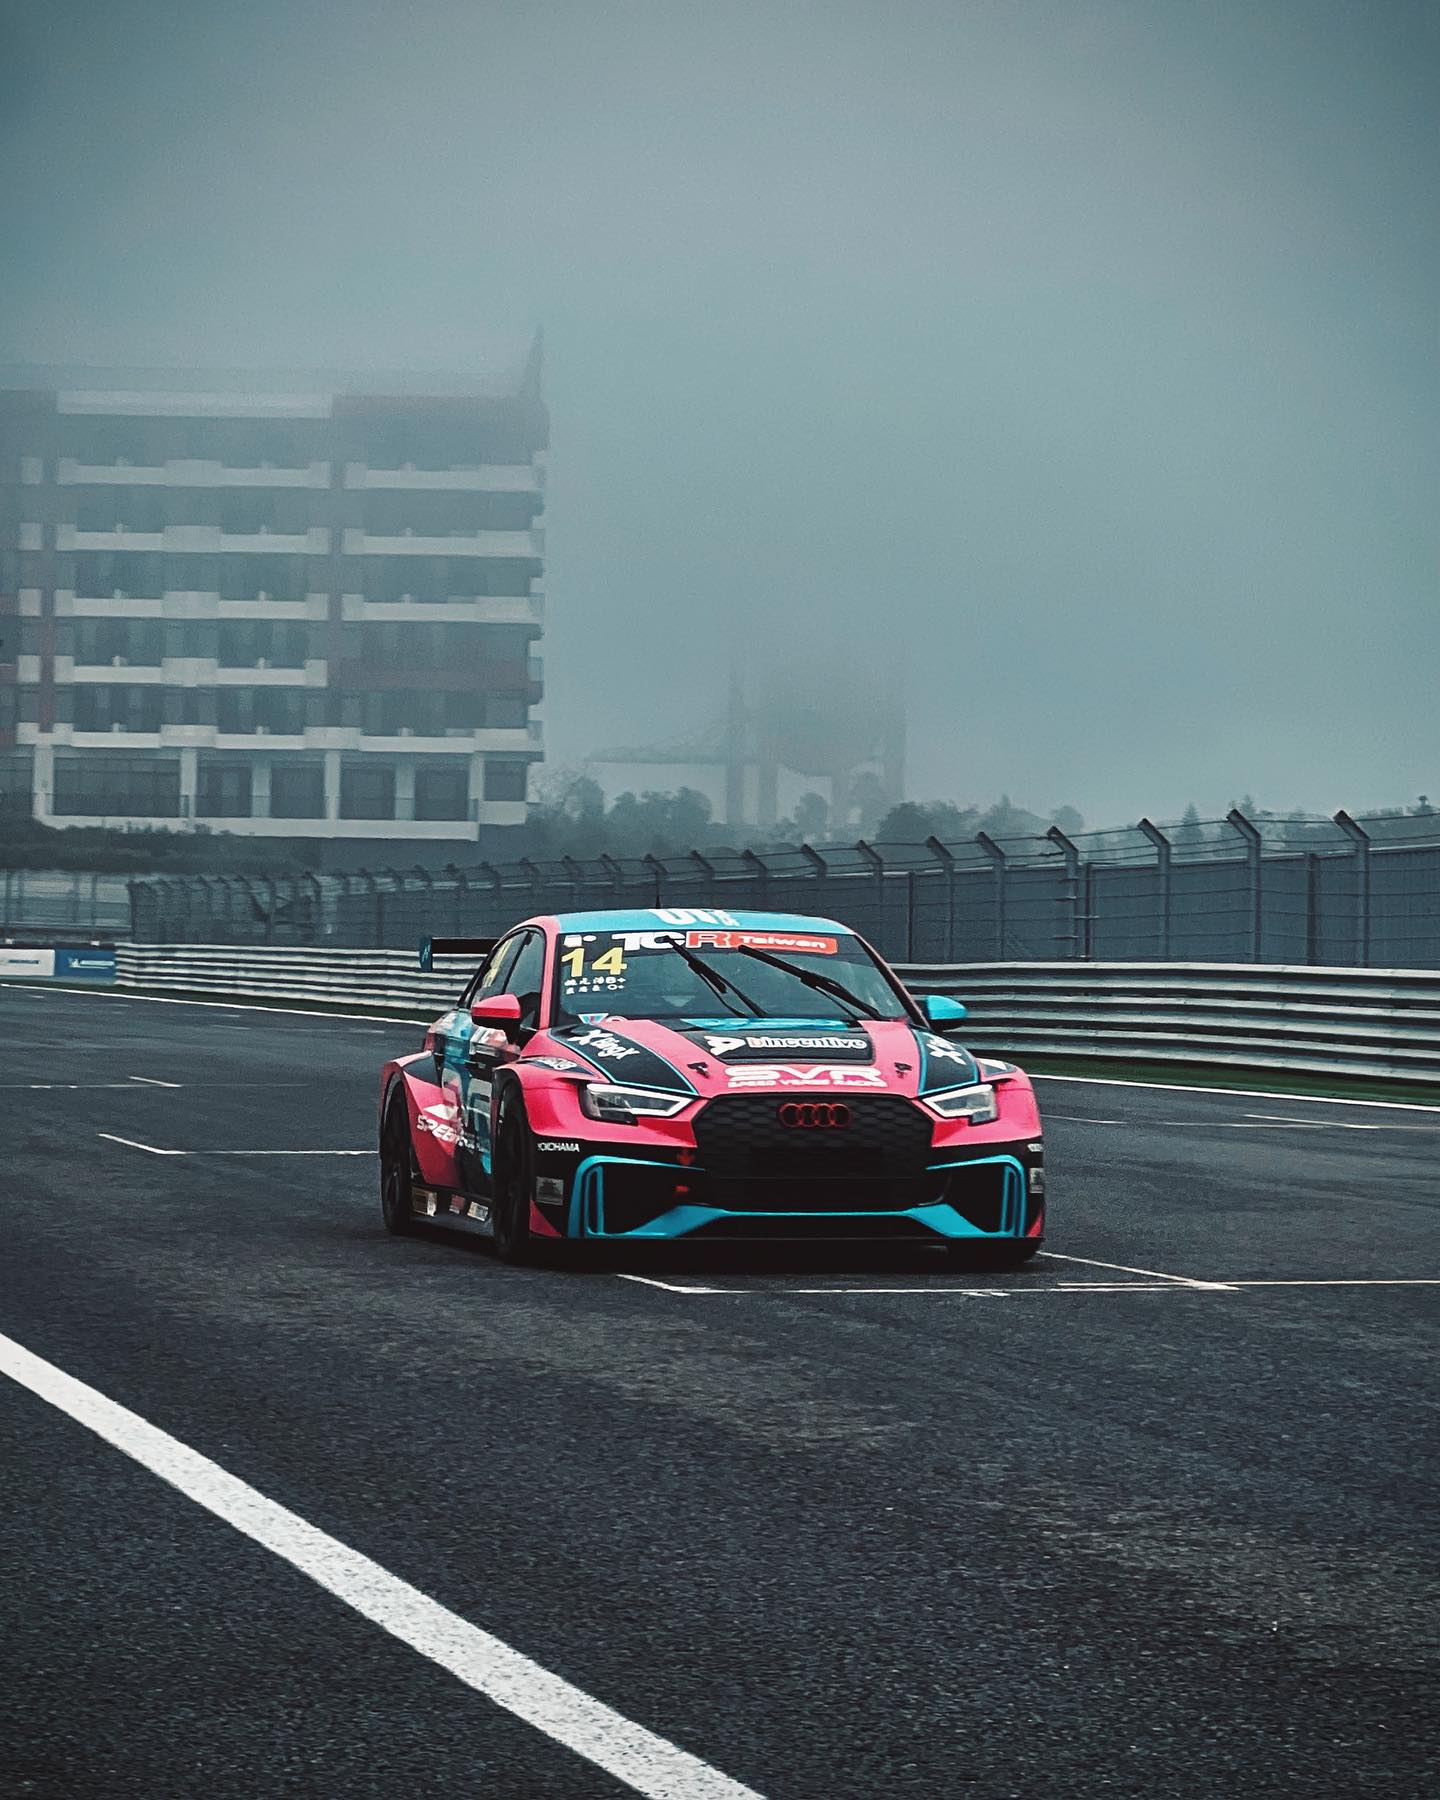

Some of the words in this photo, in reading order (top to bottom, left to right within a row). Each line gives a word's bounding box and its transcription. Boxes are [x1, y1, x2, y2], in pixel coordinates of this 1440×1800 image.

[612, 931, 731, 951] TCR
[739, 935, 827, 949] Taiwan
[561, 947, 627, 977] 14
[725, 1065, 888, 1087] SVR
